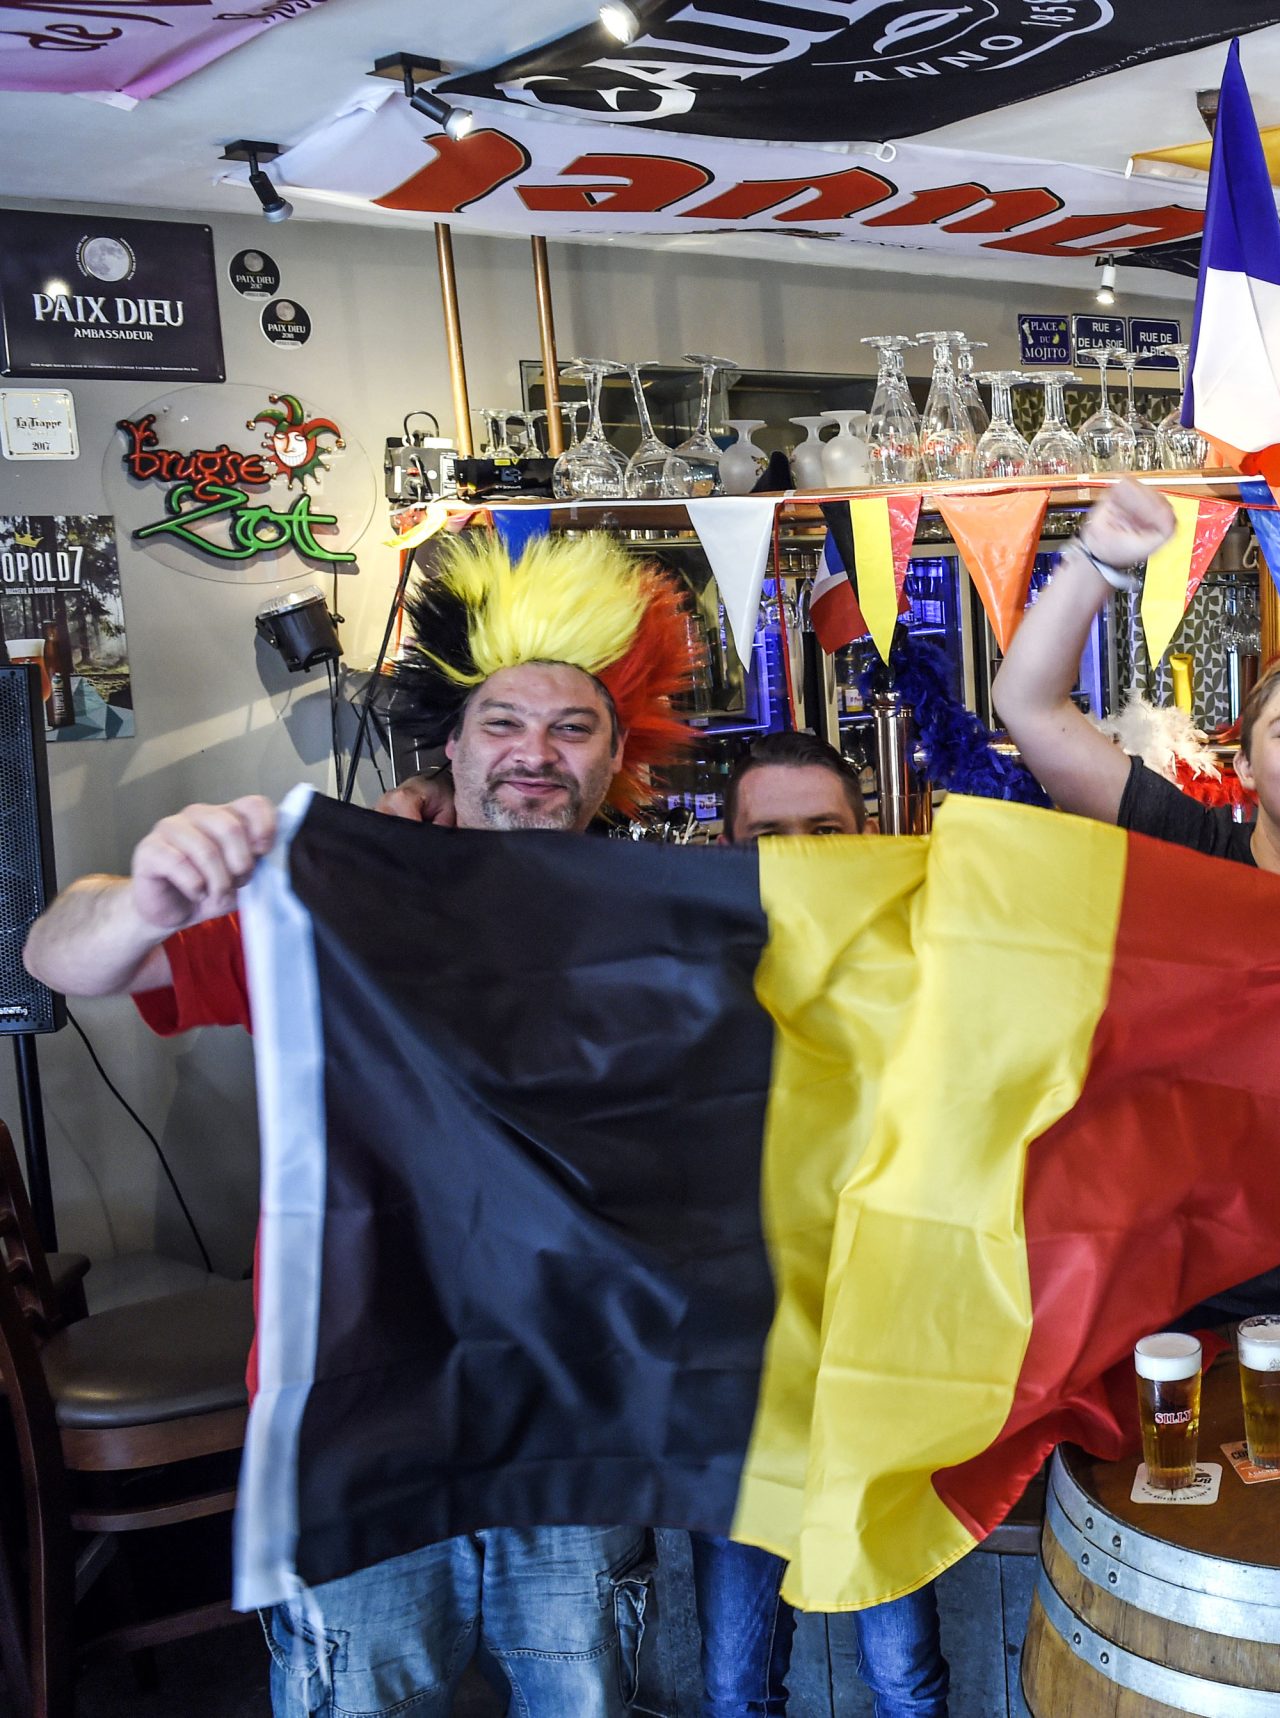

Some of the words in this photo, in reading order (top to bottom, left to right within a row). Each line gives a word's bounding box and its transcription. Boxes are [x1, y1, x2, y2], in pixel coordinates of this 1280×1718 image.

[853, 35, 1023, 83] ANNO
[236, 275, 255, 283] PAIX
[256, 276, 275, 284] DIEU
[32, 293, 110, 324] PAIX
[115, 297, 184, 327] DIEU
[267, 323, 286, 332] PAIX
[288, 325, 306, 333] DIEU
[1031, 321, 1058, 331] PLACE
[1092, 322, 1110, 332] RUE
[74, 327, 154, 341] AMBASSADEUR
[1139, 332, 1158, 343] RUE
[1160, 333, 1173, 343] DE
[1078, 337, 1090, 347] DE
[1092, 339, 1104, 348] LA
[1025, 347, 1067, 360] MOJITO
[28, 417, 62, 430] Trappe
[133, 484, 357, 561] Zot
[0, 546, 83, 584] OPOLD7
[1155, 1409, 1193, 1425] SILLY
